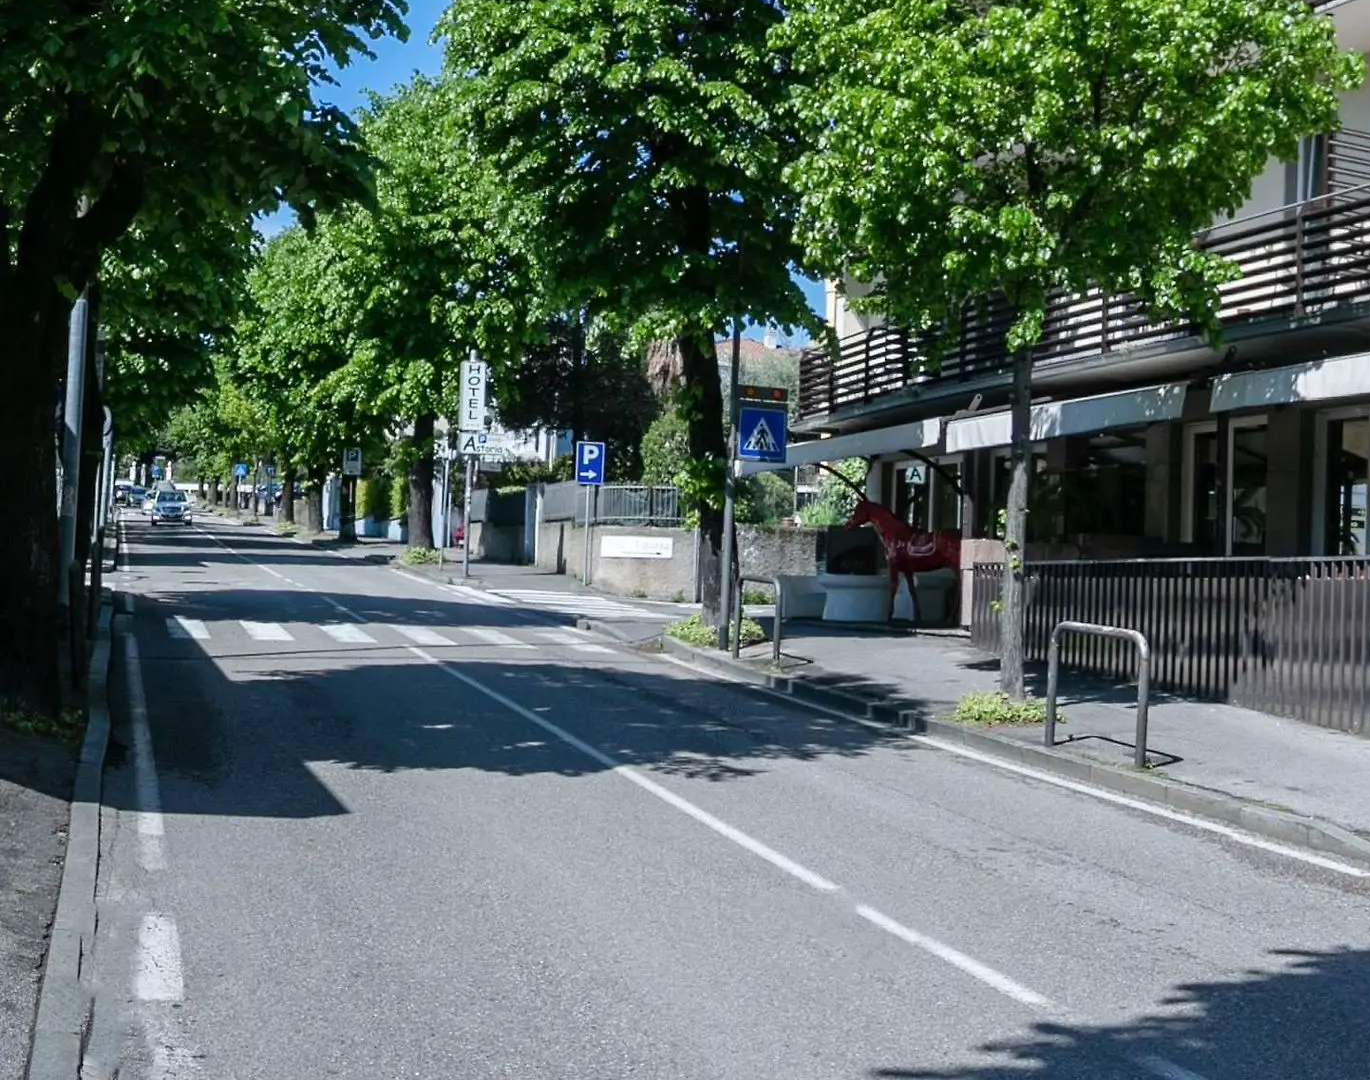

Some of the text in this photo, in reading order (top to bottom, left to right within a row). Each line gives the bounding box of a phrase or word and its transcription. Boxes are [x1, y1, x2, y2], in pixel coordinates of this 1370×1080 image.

[468, 364, 481, 420] HOTEL
[583, 445, 600, 465] P
[910, 466, 922, 481] A
